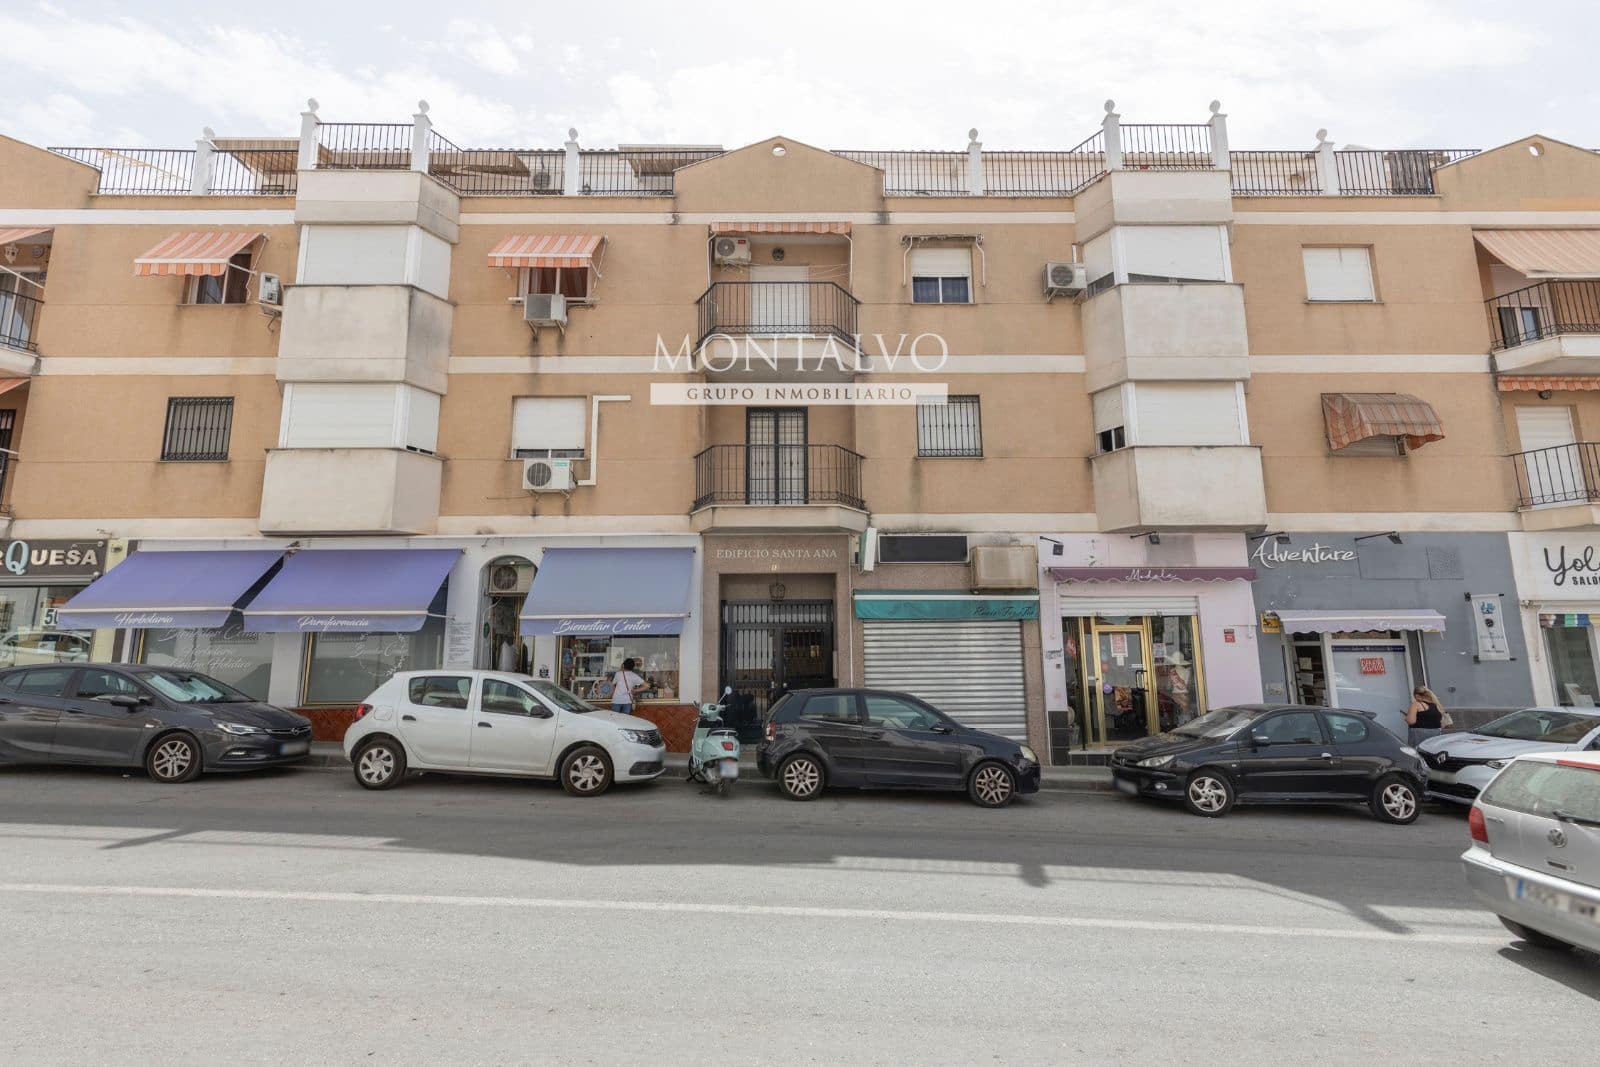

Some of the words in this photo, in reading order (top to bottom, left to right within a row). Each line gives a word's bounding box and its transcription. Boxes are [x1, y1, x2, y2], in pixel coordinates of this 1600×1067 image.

[0, 540, 97, 575] QUESA
[717, 549, 768, 559] EDIFICIO
[772, 549, 811, 559] SANTA
[812, 549, 837, 559] ANA
[1250, 537, 1357, 568] Adventure
[1544, 545, 1600, 586] Yol
[1572, 574, 1600, 586] SALÓ
[553, 618, 610, 634] Bienestar
[612, 619, 652, 632] Center
